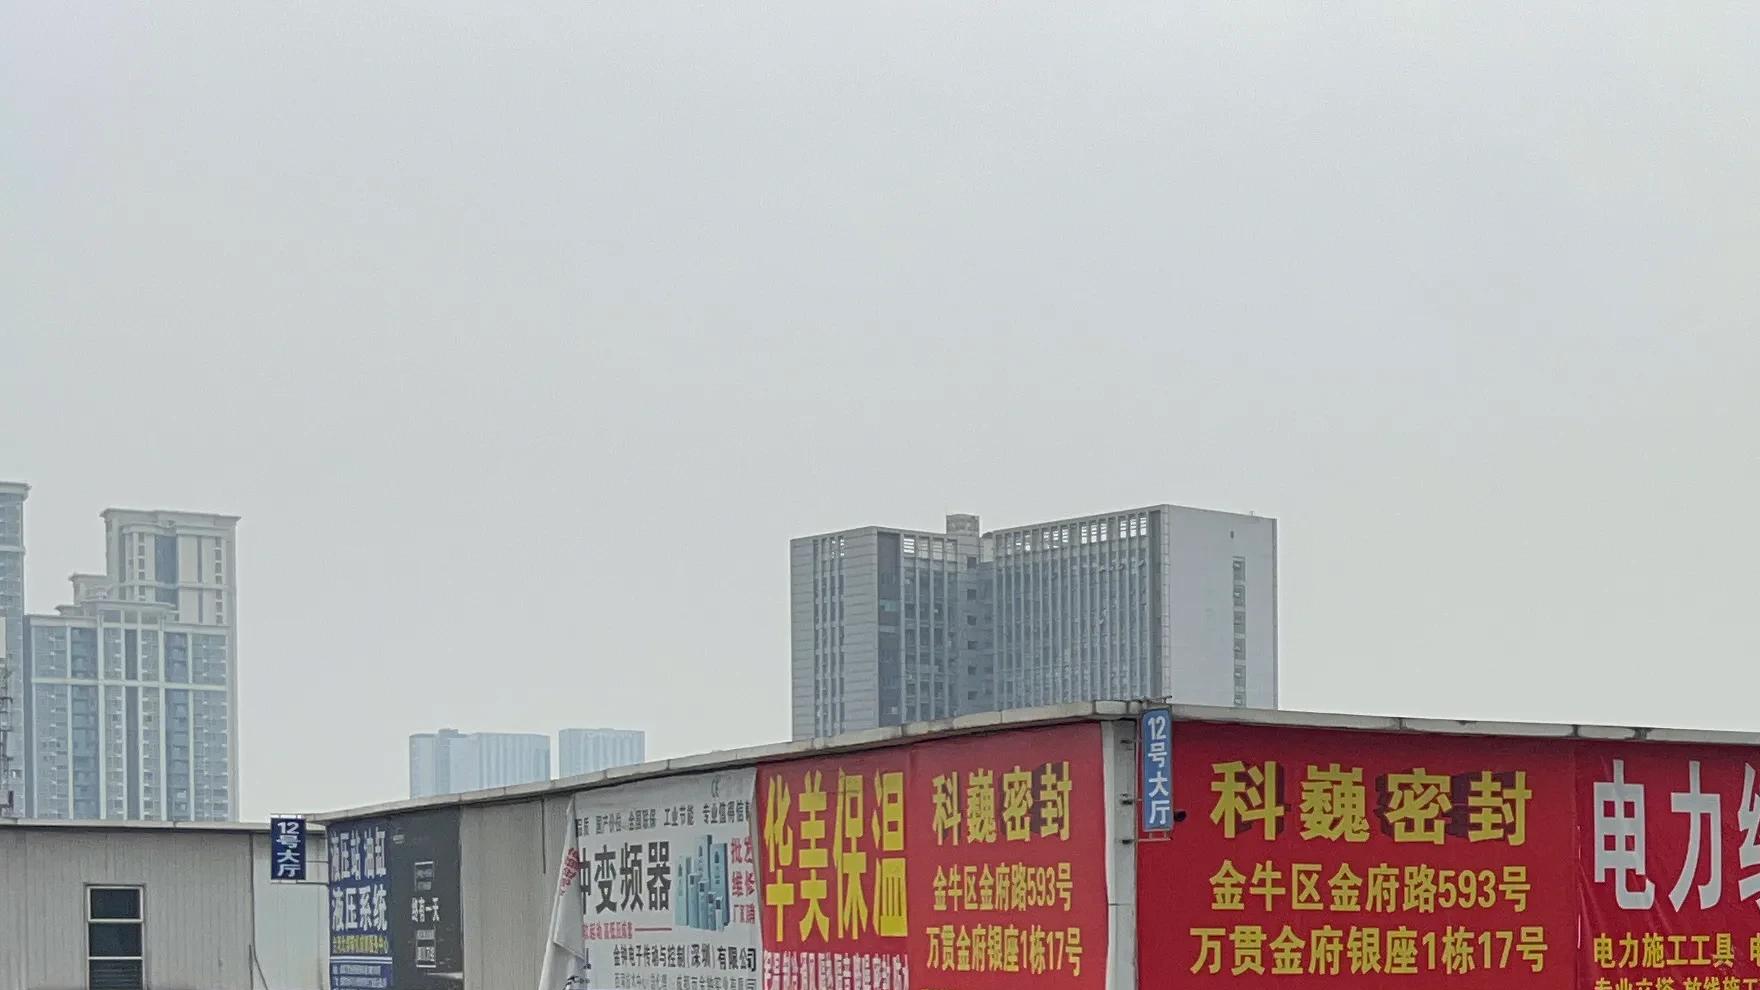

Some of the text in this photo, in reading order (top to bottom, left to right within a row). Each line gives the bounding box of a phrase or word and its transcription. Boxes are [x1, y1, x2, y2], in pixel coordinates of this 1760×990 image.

[1148, 716, 1169, 826] 12号大厅
[931, 761, 1073, 845] 科巍密封
[1210, 761, 1532, 846] 科巍密封
[275, 821, 299, 878] 12号大厅
[765, 768, 909, 943] 华美保温
[932, 862, 1073, 912] 金牛区金府路593号
[1209, 860, 1532, 912] 金牛区金府路593号
[926, 926, 1083, 976] 万贯金府银座1栋17号
[1190, 925, 1548, 975] 万贯金府银座1栋17号
[1593, 933, 1735, 969] 电力施工工具
